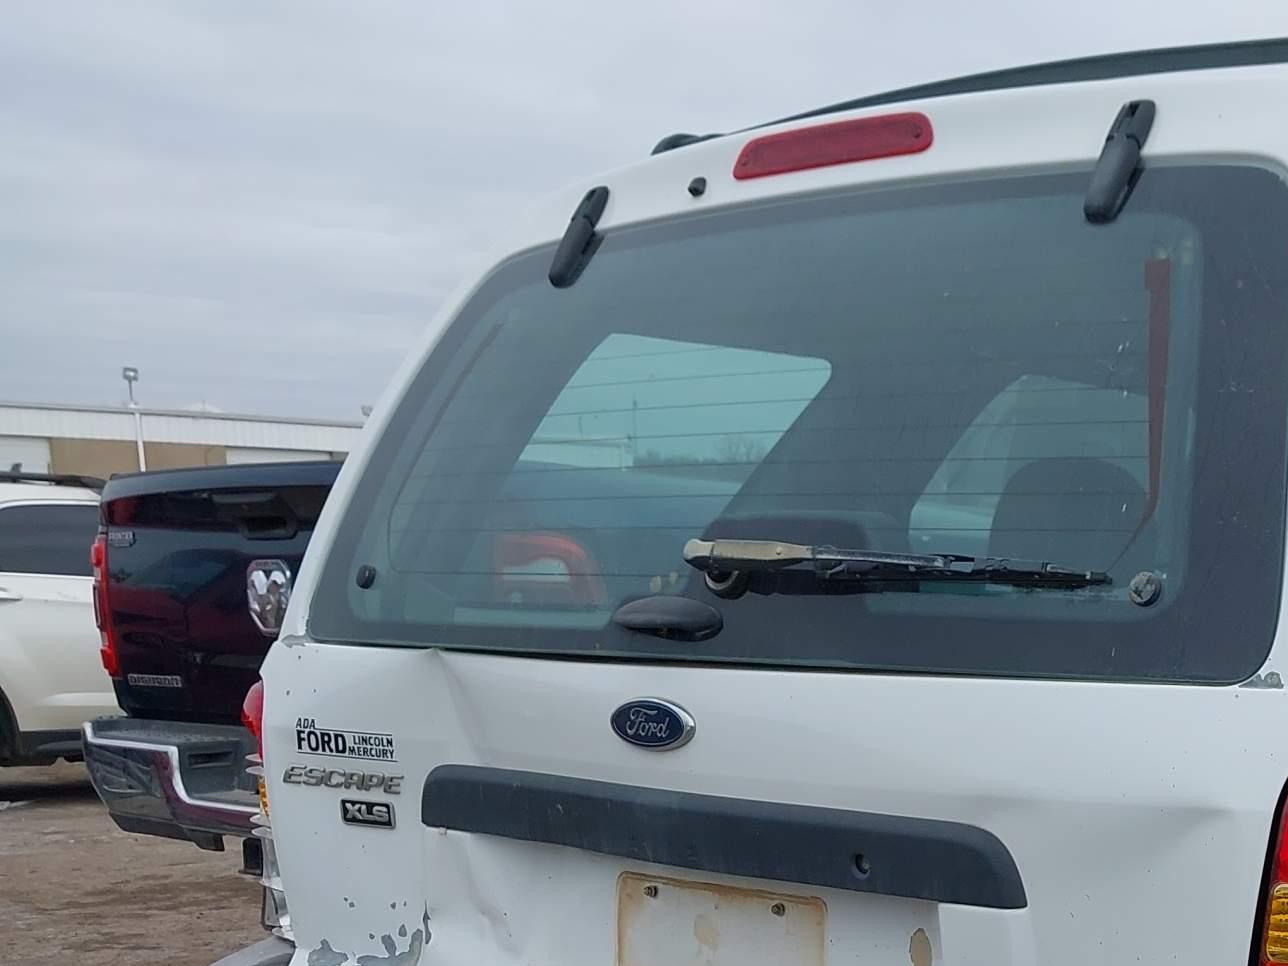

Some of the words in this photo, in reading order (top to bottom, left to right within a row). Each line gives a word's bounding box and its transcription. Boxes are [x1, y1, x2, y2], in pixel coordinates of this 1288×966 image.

[295, 717, 316, 729] ADA
[625, 707, 670, 738] Ford
[296, 729, 347, 754] FORD
[352, 734, 394, 748] LINCOLN
[347, 745, 395, 759] MERCURY
[283, 765, 404, 795] ESCAPE
[344, 802, 390, 822] XLS
